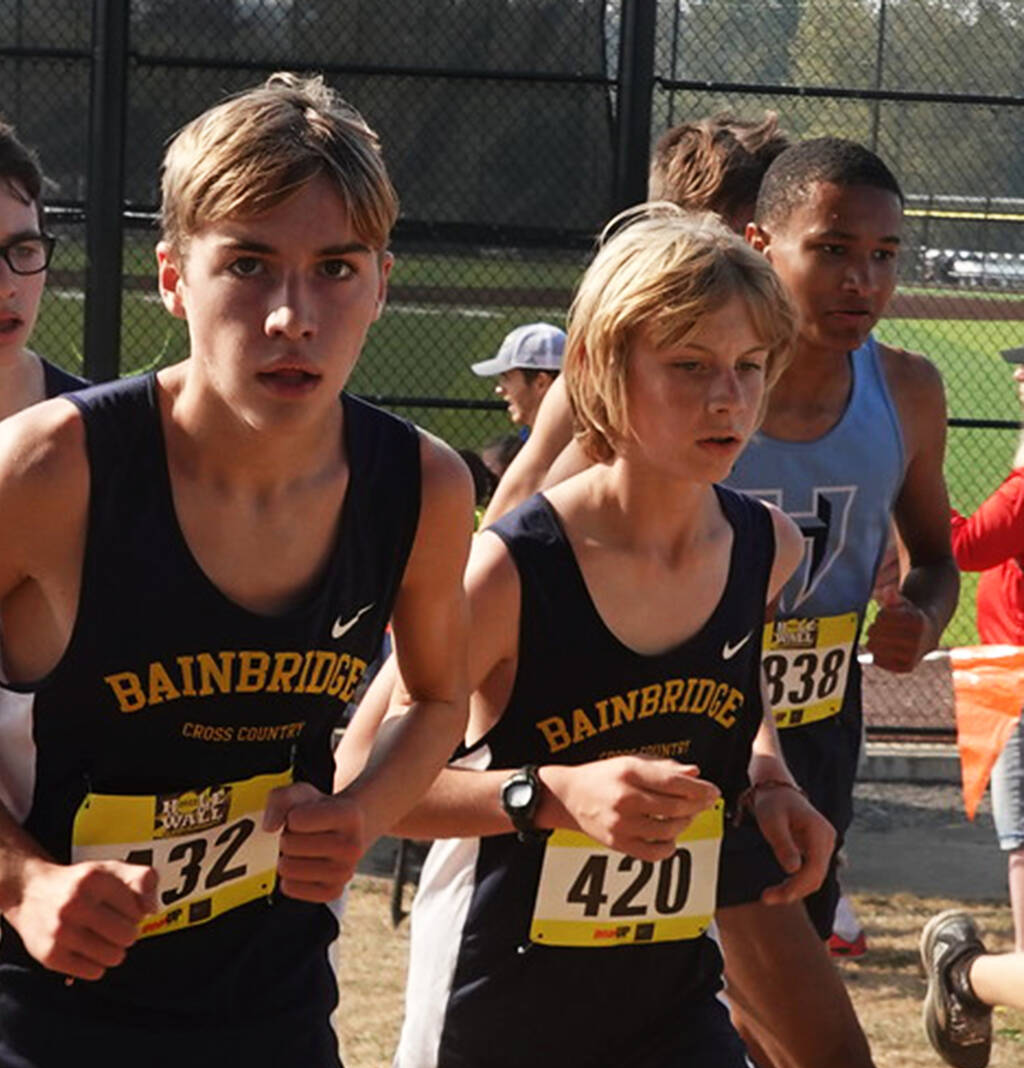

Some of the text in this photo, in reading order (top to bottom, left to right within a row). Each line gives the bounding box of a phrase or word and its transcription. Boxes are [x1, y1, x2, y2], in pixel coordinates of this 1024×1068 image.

[104, 650, 368, 714] BAINBRIDGE
[182, 720, 306, 741] CROSS COUNTRY
[536, 677, 745, 754] BAINBRIDGE
[164, 807, 226, 830] WALL
[566, 848, 693, 918] 420
